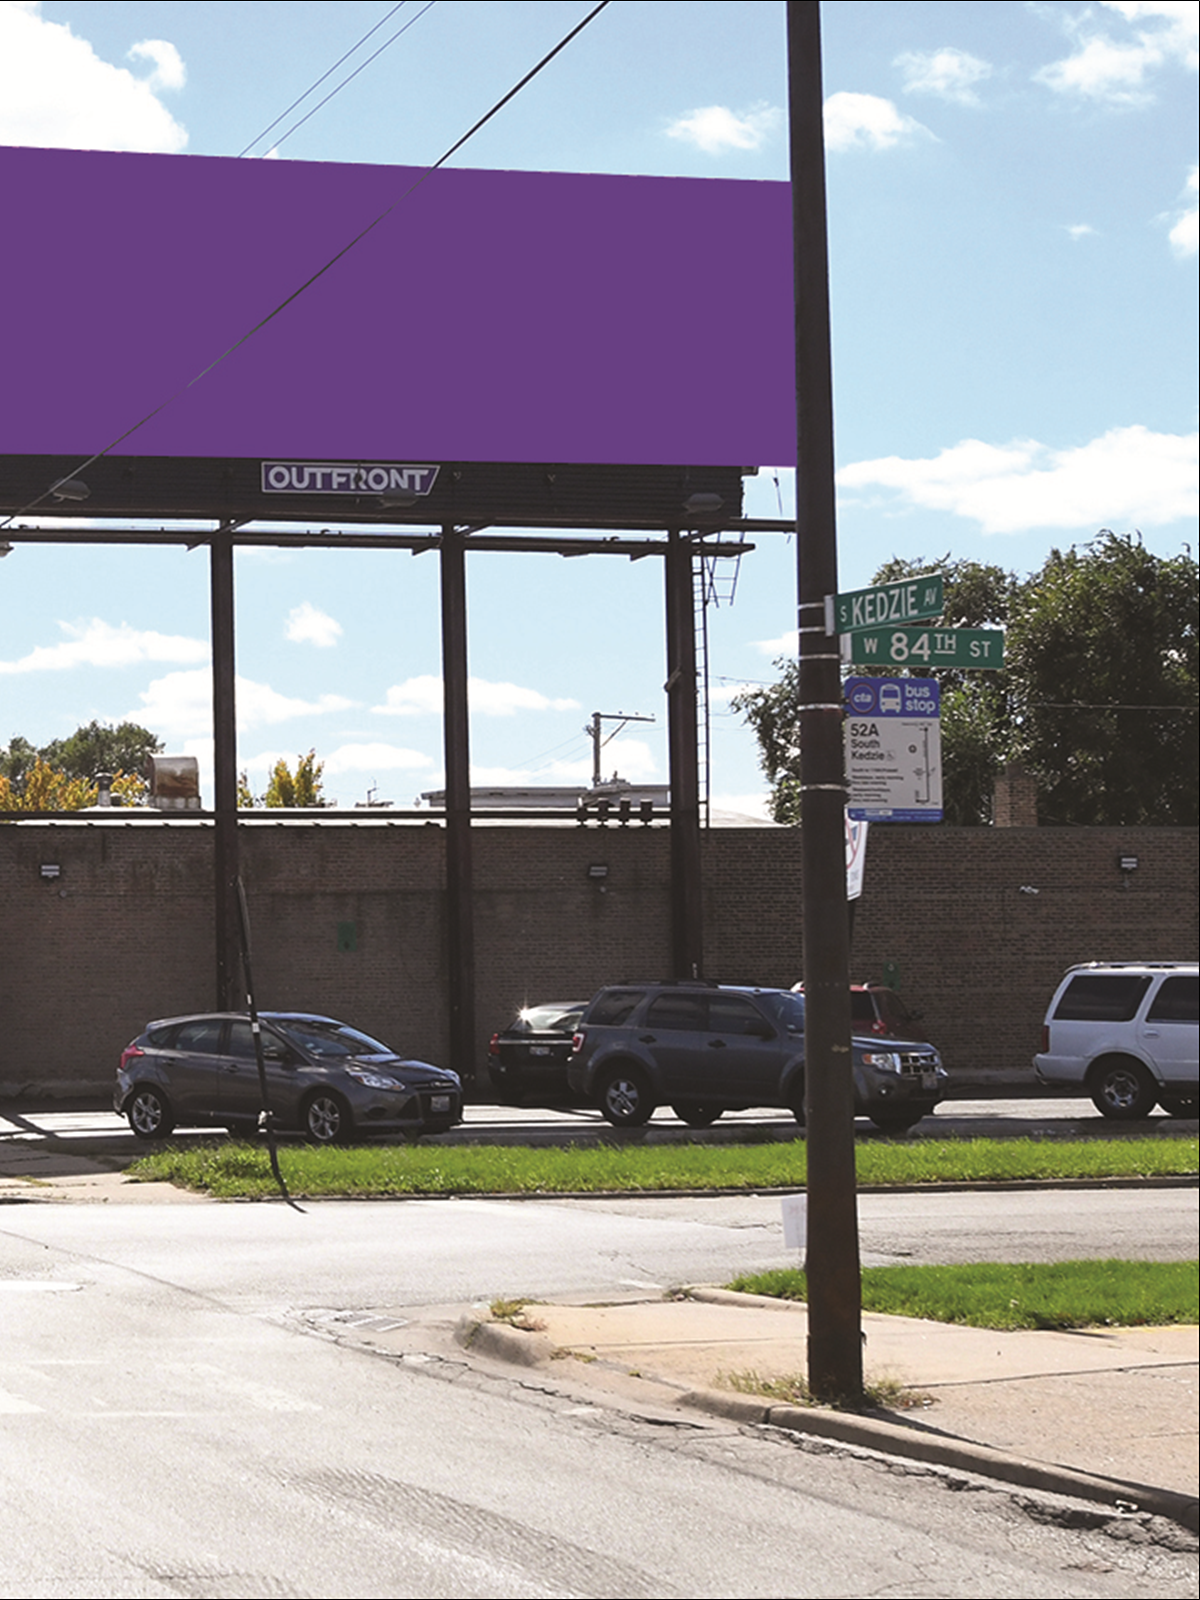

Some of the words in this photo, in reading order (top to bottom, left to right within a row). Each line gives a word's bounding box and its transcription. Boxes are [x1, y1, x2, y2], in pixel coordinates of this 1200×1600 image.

[268, 466, 429, 491] OUTFRONT
[840, 605, 848, 622] S
[852, 585, 919, 627] KEDZIE
[923, 587, 938, 607] AV
[863, 638, 878, 654] W
[890, 632, 957, 662] 84TH
[969, 640, 992, 658] ST
[853, 692, 873, 703] cta
[905, 683, 931, 698] bus
[905, 698, 936, 715] stop
[850, 723, 880, 738] 52A
[851, 739, 881, 749] South
[851, 750, 885, 760] Kedzie
